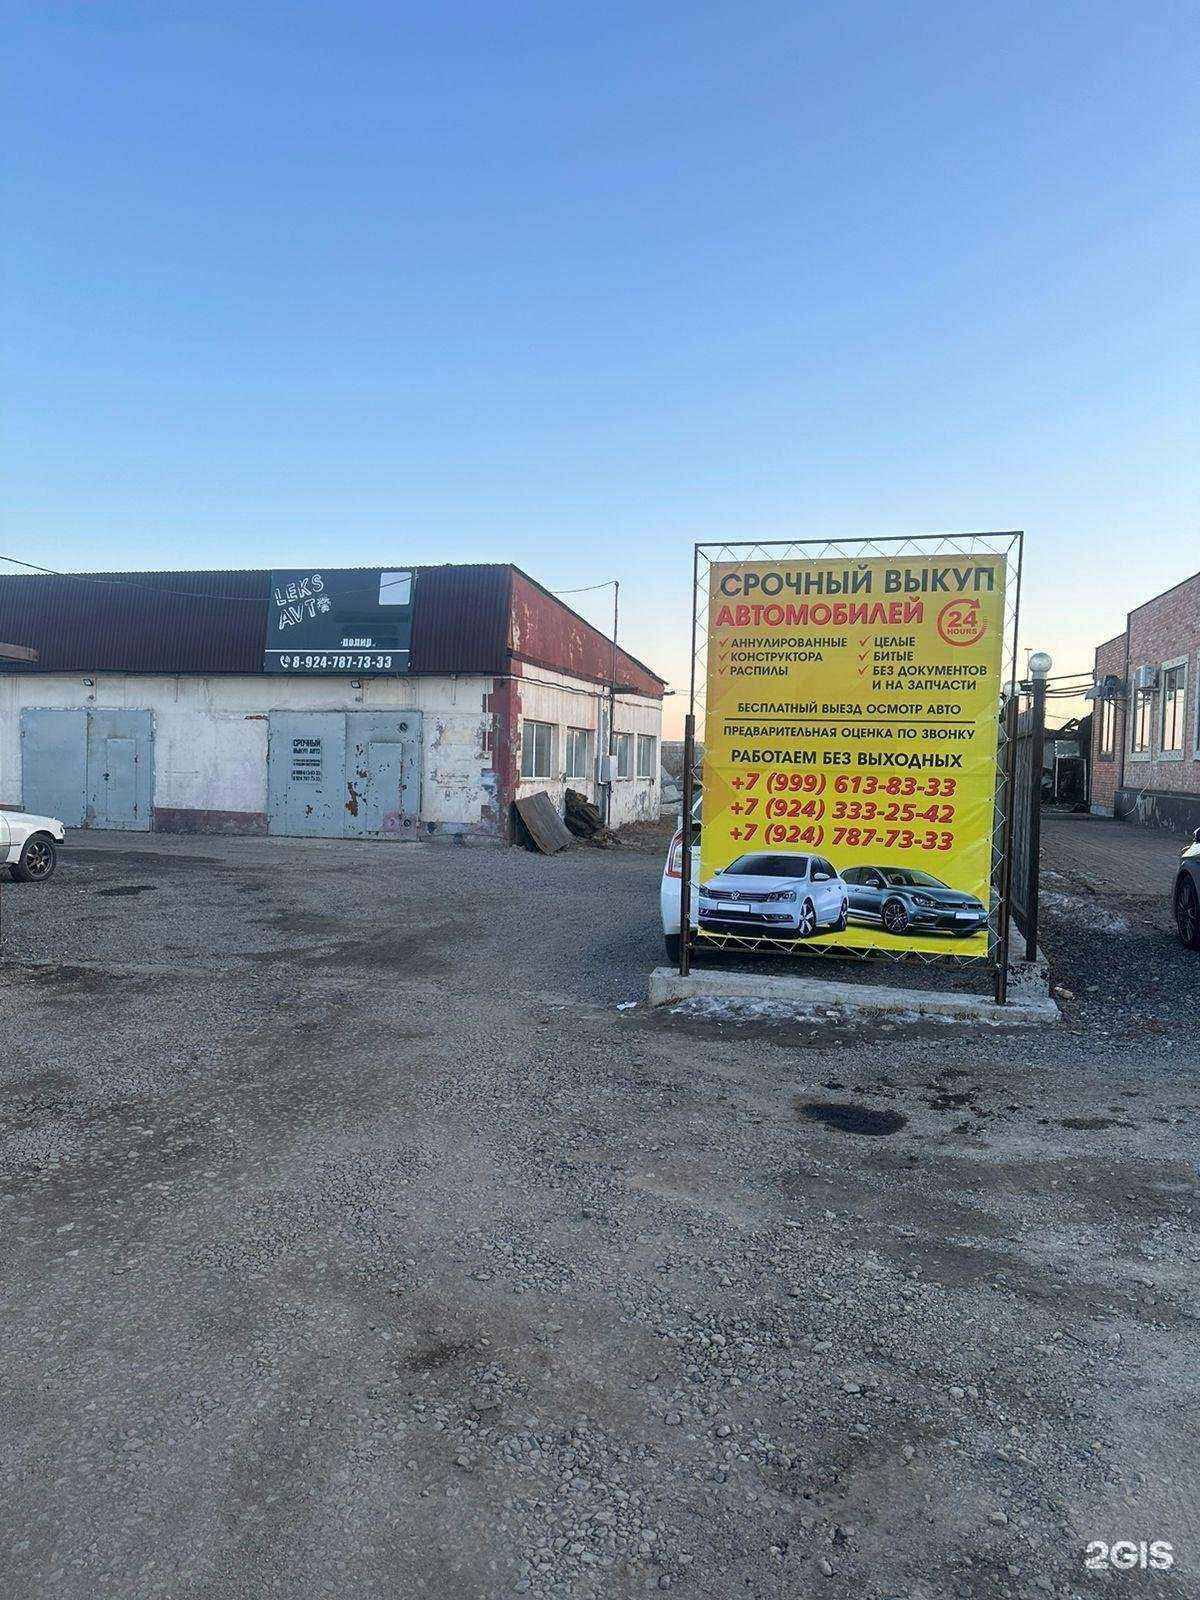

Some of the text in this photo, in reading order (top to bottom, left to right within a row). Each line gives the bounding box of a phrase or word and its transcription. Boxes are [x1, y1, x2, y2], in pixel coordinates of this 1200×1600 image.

[720, 563, 994, 597] СРОЧНЫЙ ВЫКУП
[275, 574, 324, 606] LEKS
[715, 596, 925, 627] АВТОМОБИЛЕЙ
[948, 610, 978, 628] 24
[731, 637, 848, 648] АННУЛИРОВАННЫЕ
[874, 637, 915, 648] ЦЕЛЫЕ
[292, 655, 393, 669] 8-924-787-73-33
[730, 651, 823, 662] КОНСТРУКТОРА
[873, 651, 914, 662] БИТЫЕ
[730, 665, 789, 676] РАСПИЛЫ
[873, 665, 988, 677] БЕЗ ДОКУМЕНТОВ
[872, 680, 977, 691] И НА ЗАПЧАСТИ
[738, 700, 962, 716] БЕСПЛАТНЫЙ ВЫЕЗД ОСМОТР АВТО
[724, 725, 975, 740] ПРЕДВАРИТЕЛЬНАЯ ОЦЕНКА ПО ЗВОНКУ
[731, 750, 963, 769] РАБОТАЕМ БЕЗ ВЫХОДНЫХ
[731, 772, 957, 797] +7 (999) 613-83-33
[730, 798, 956, 824] +7 (924) 333-25-42
[729, 823, 955, 851] +7 (924) 787-73-33
